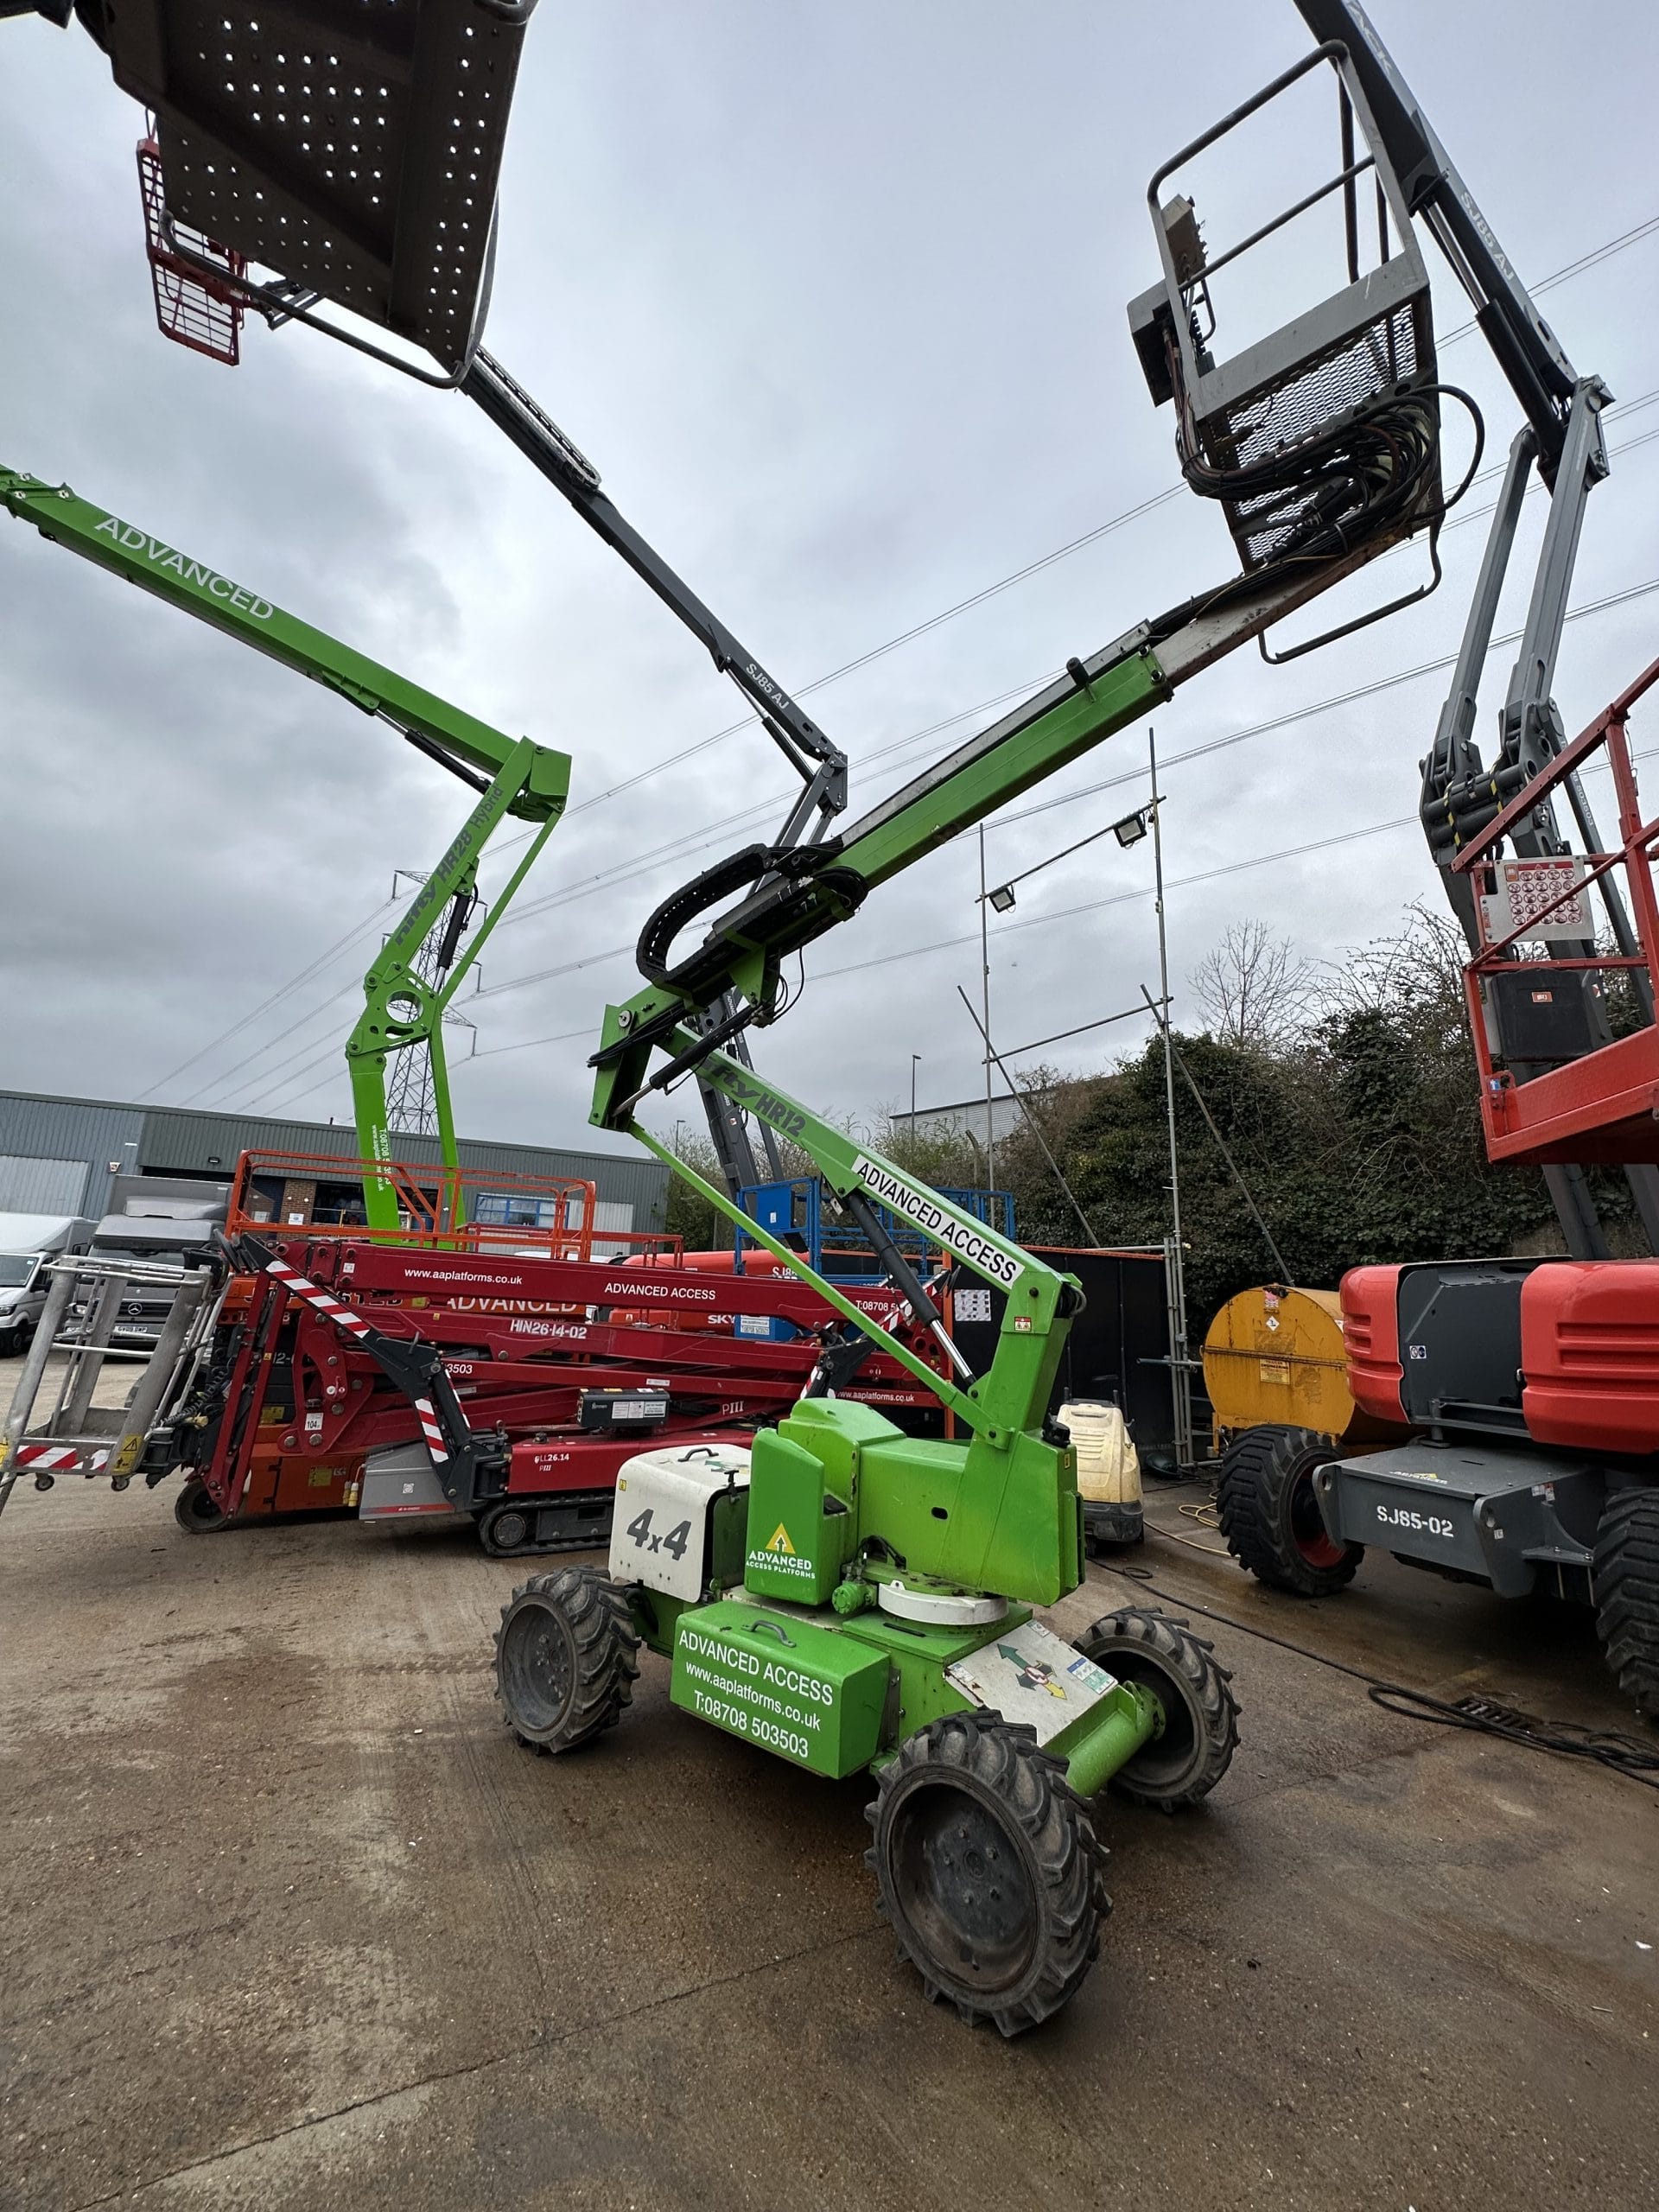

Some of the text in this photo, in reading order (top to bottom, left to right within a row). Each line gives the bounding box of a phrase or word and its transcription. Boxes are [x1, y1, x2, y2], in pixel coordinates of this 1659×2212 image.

[1460, 191, 1515, 281] SJ85 AJ
[94, 517, 274, 620] ADVANCED
[746, 663, 790, 709] SJ85 AJ
[435, 828, 474, 883] HR28
[467, 784, 505, 830] Hybrid
[754, 1092, 806, 1138] HR12
[378, 1128, 390, 1156] T:08708
[857, 1162, 1017, 1282] ADVANCED ACCESS
[404, 1268, 523, 1285] www.aaplatforms.co.uk
[604, 1282, 716, 1300] ADVANCED ACCESS
[855, 1300, 890, 1312] T:08708
[626, 1508, 692, 1561] 4x4
[1376, 1504, 1454, 1538] SJ85-02
[746, 1560, 817, 1580] ACCESS PLATFORMS
[748, 1549, 813, 1571] ADVANCED
[678, 1629, 835, 1707] ADVANCED ACCESS
[685, 1661, 822, 1732] www.aaplatforms.co.uk
[694, 1689, 810, 1758] T:08708 503503
